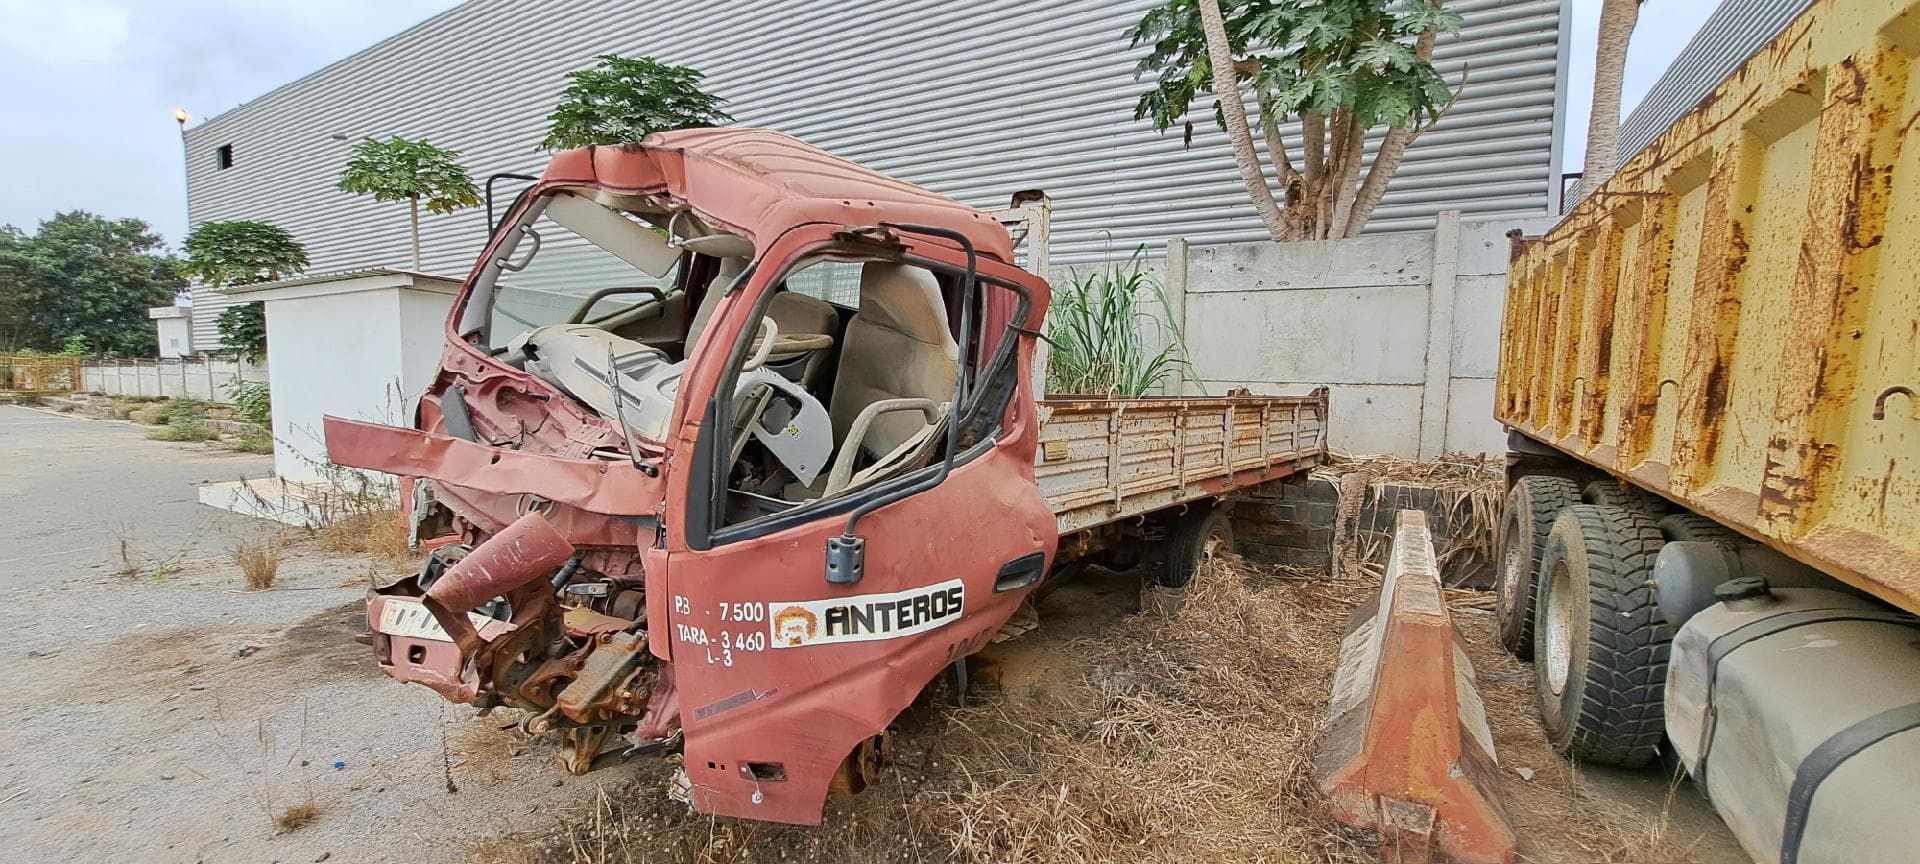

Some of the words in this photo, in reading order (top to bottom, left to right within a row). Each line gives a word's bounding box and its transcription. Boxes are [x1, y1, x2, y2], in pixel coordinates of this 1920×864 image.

[719, 602, 764, 622] 7.500
[825, 586, 963, 637] ANTEROS
[721, 630, 765, 652] 3.460
